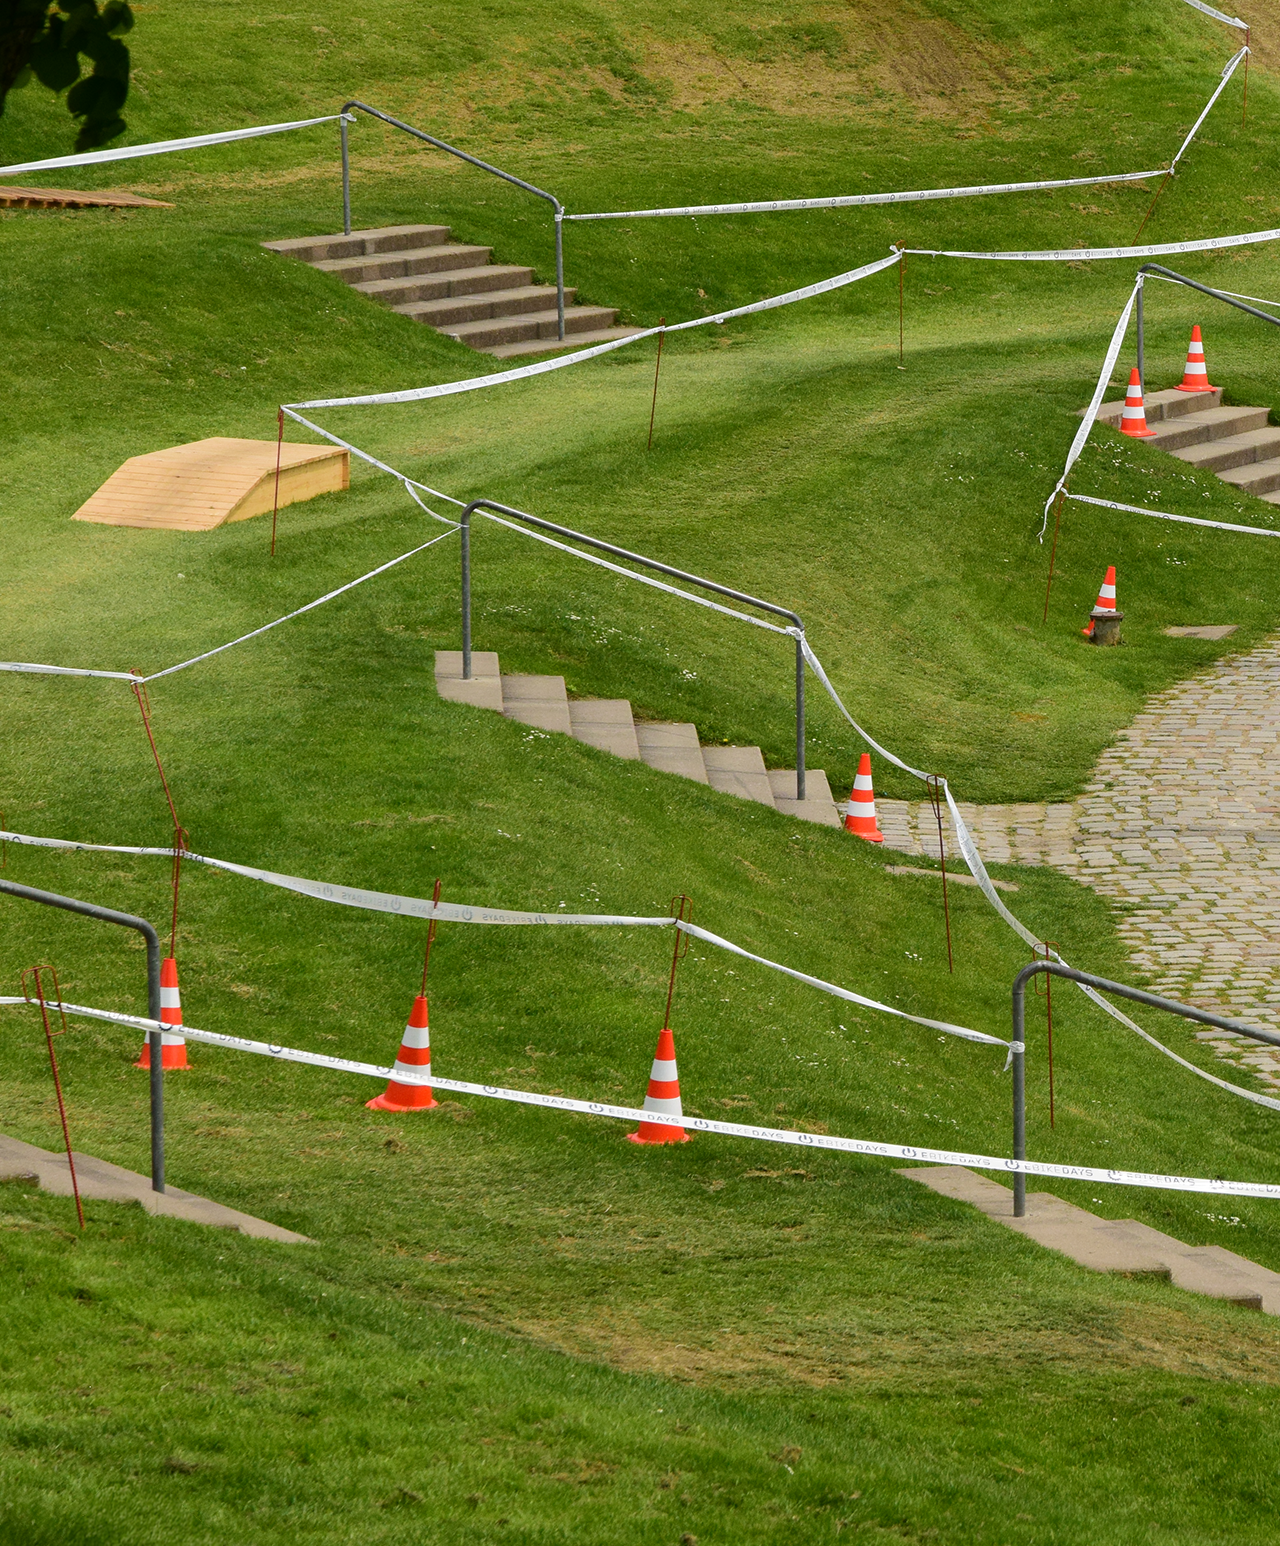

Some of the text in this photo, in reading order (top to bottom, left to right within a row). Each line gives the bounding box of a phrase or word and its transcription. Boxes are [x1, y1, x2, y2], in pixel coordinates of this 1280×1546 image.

[608, 1108, 680, 1125] EBIKEDAYS
[713, 1124, 784, 1140] EBIKEDAYS
[817, 1138, 888, 1154] EBIKEDAYS
[921, 1152, 991, 1167] EBIKEDAYS
